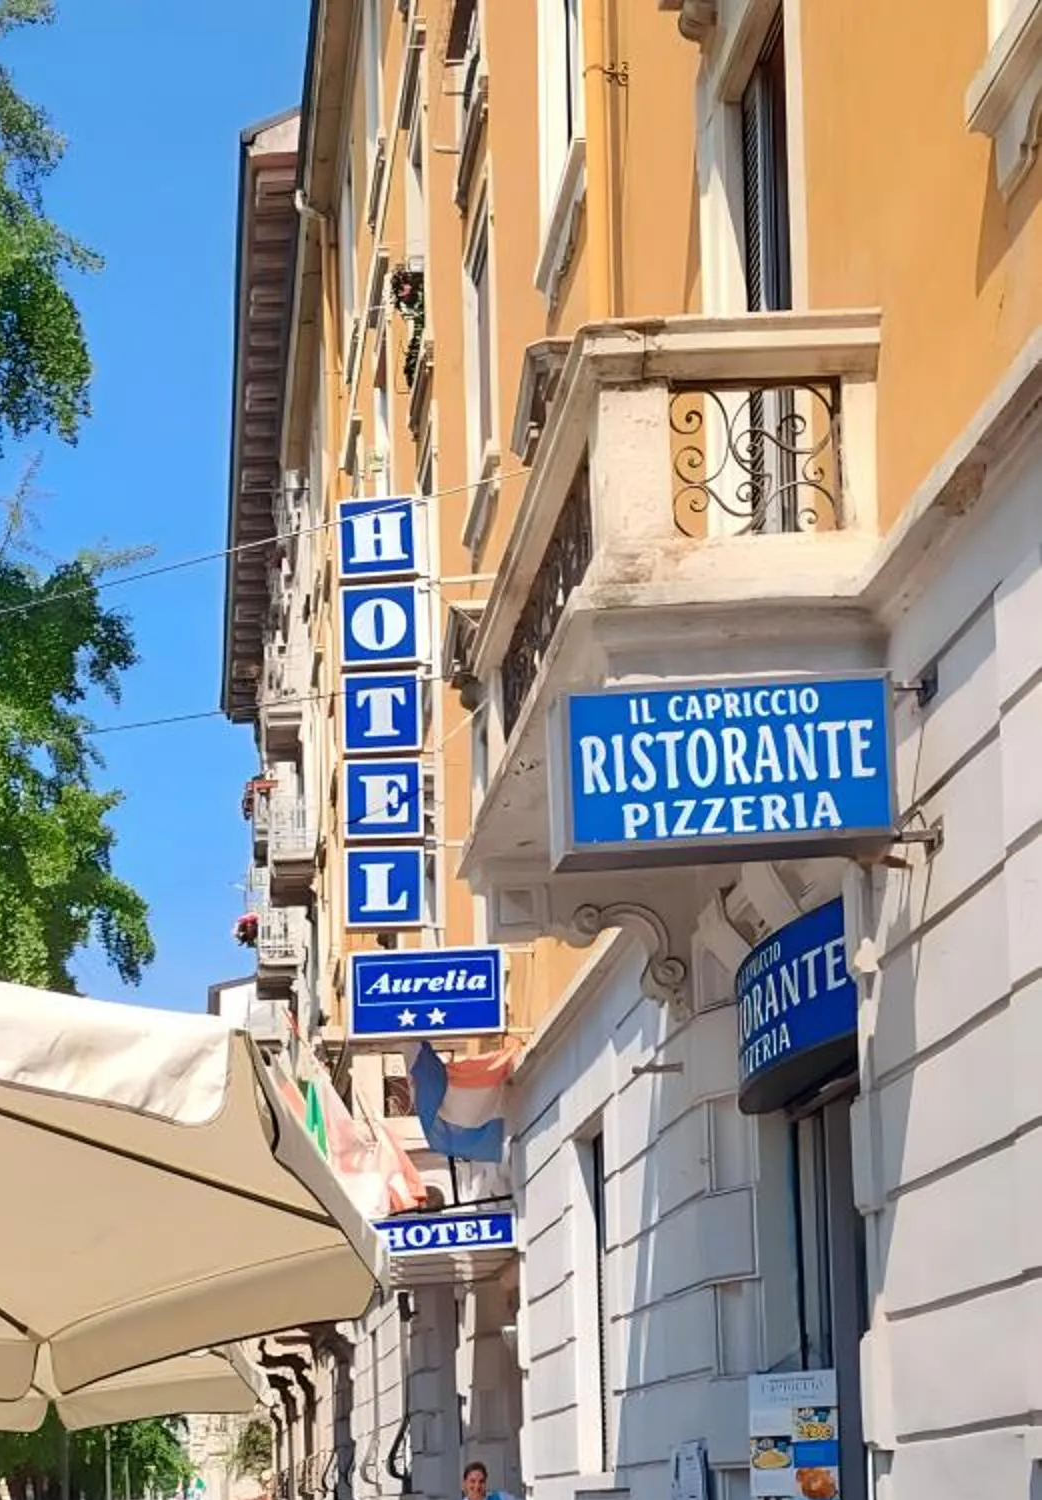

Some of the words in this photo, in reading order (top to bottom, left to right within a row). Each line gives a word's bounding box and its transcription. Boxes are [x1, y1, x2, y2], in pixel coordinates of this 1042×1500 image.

[349, 511, 410, 912] HOTEL
[629, 698, 656, 725] IL
[668, 686, 819, 723] CAPRICCIO
[579, 719, 877, 795] RISTORANTE
[622, 791, 842, 839] PIZZERIA
[365, 969, 487, 995] Aurelia
[388, 1219, 503, 1248] HOTEL
